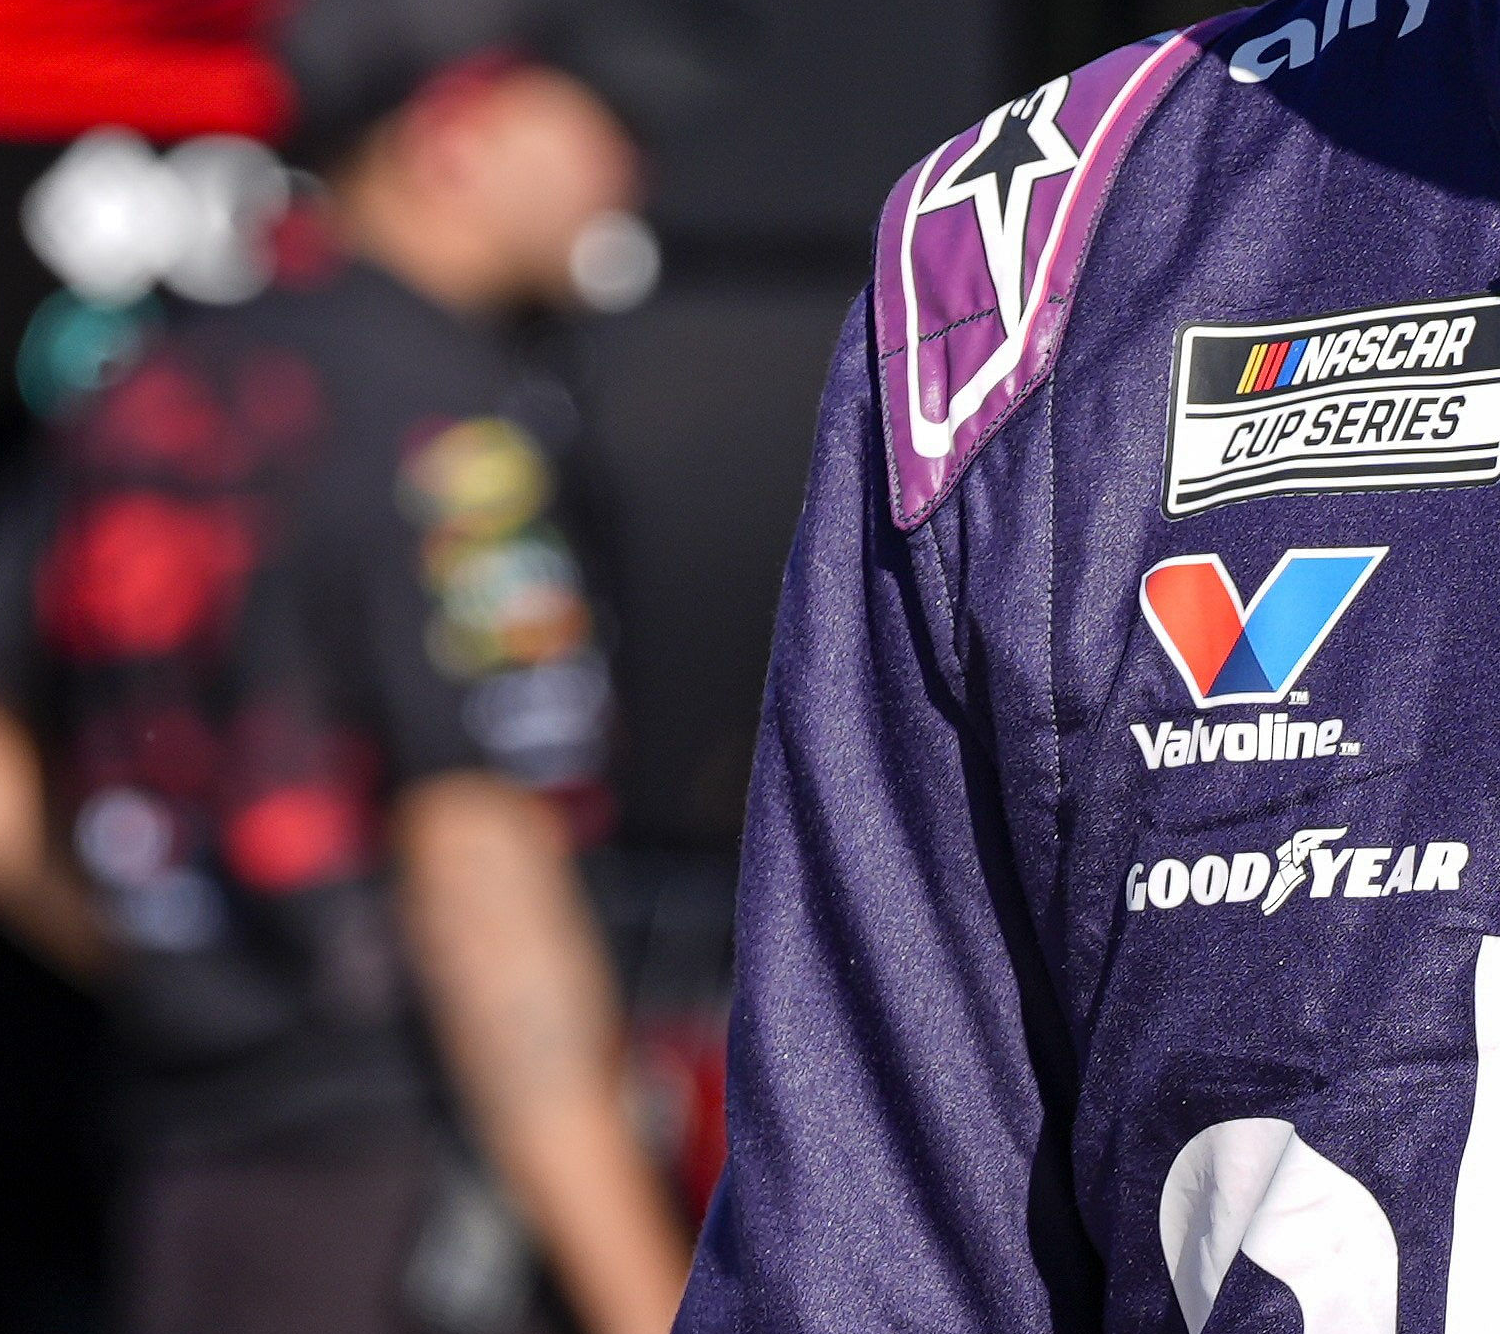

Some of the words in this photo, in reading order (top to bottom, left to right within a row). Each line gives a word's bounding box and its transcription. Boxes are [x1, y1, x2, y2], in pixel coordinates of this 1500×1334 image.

[1290, 316, 1477, 386] NASCAR
[1221, 409, 1307, 466] CUP
[1303, 394, 1467, 447] SERIES
[1130, 712, 1343, 770] Valvoline
